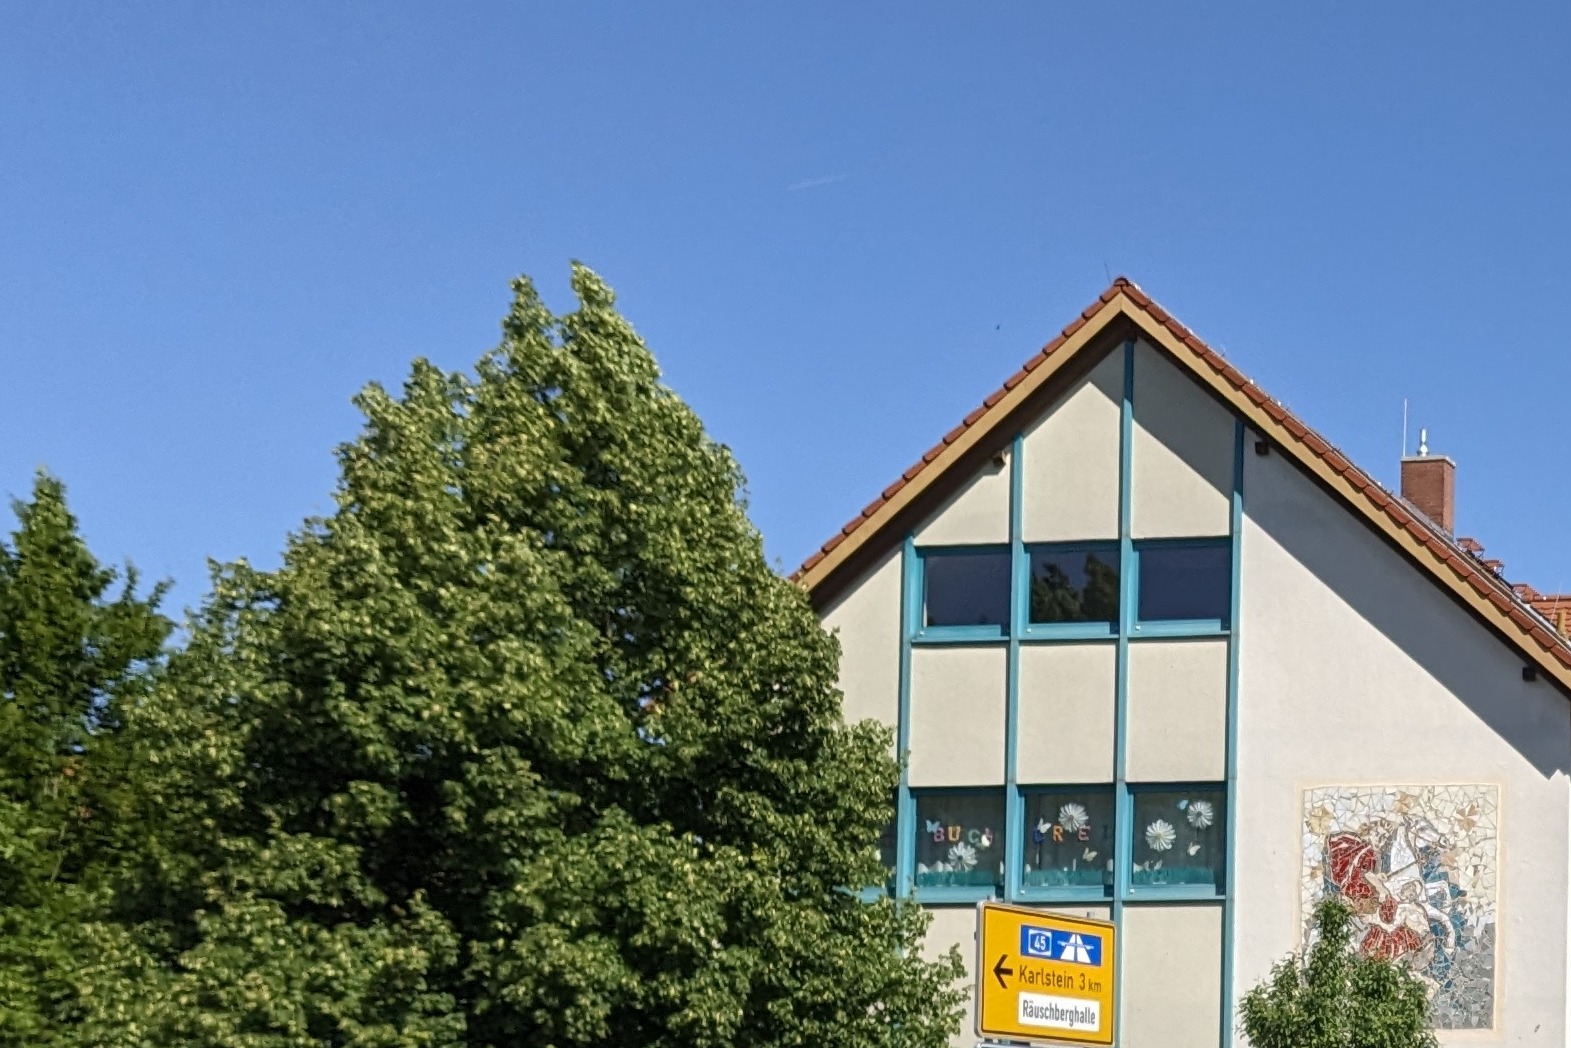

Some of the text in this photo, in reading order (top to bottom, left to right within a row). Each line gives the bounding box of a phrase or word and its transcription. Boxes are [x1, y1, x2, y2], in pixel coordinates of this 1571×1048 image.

[1034, 935, 1046, 951] 45
[1019, 964, 1102, 992] Karlstein 3 km
[1022, 999, 1096, 1027] Räuschberghalle
